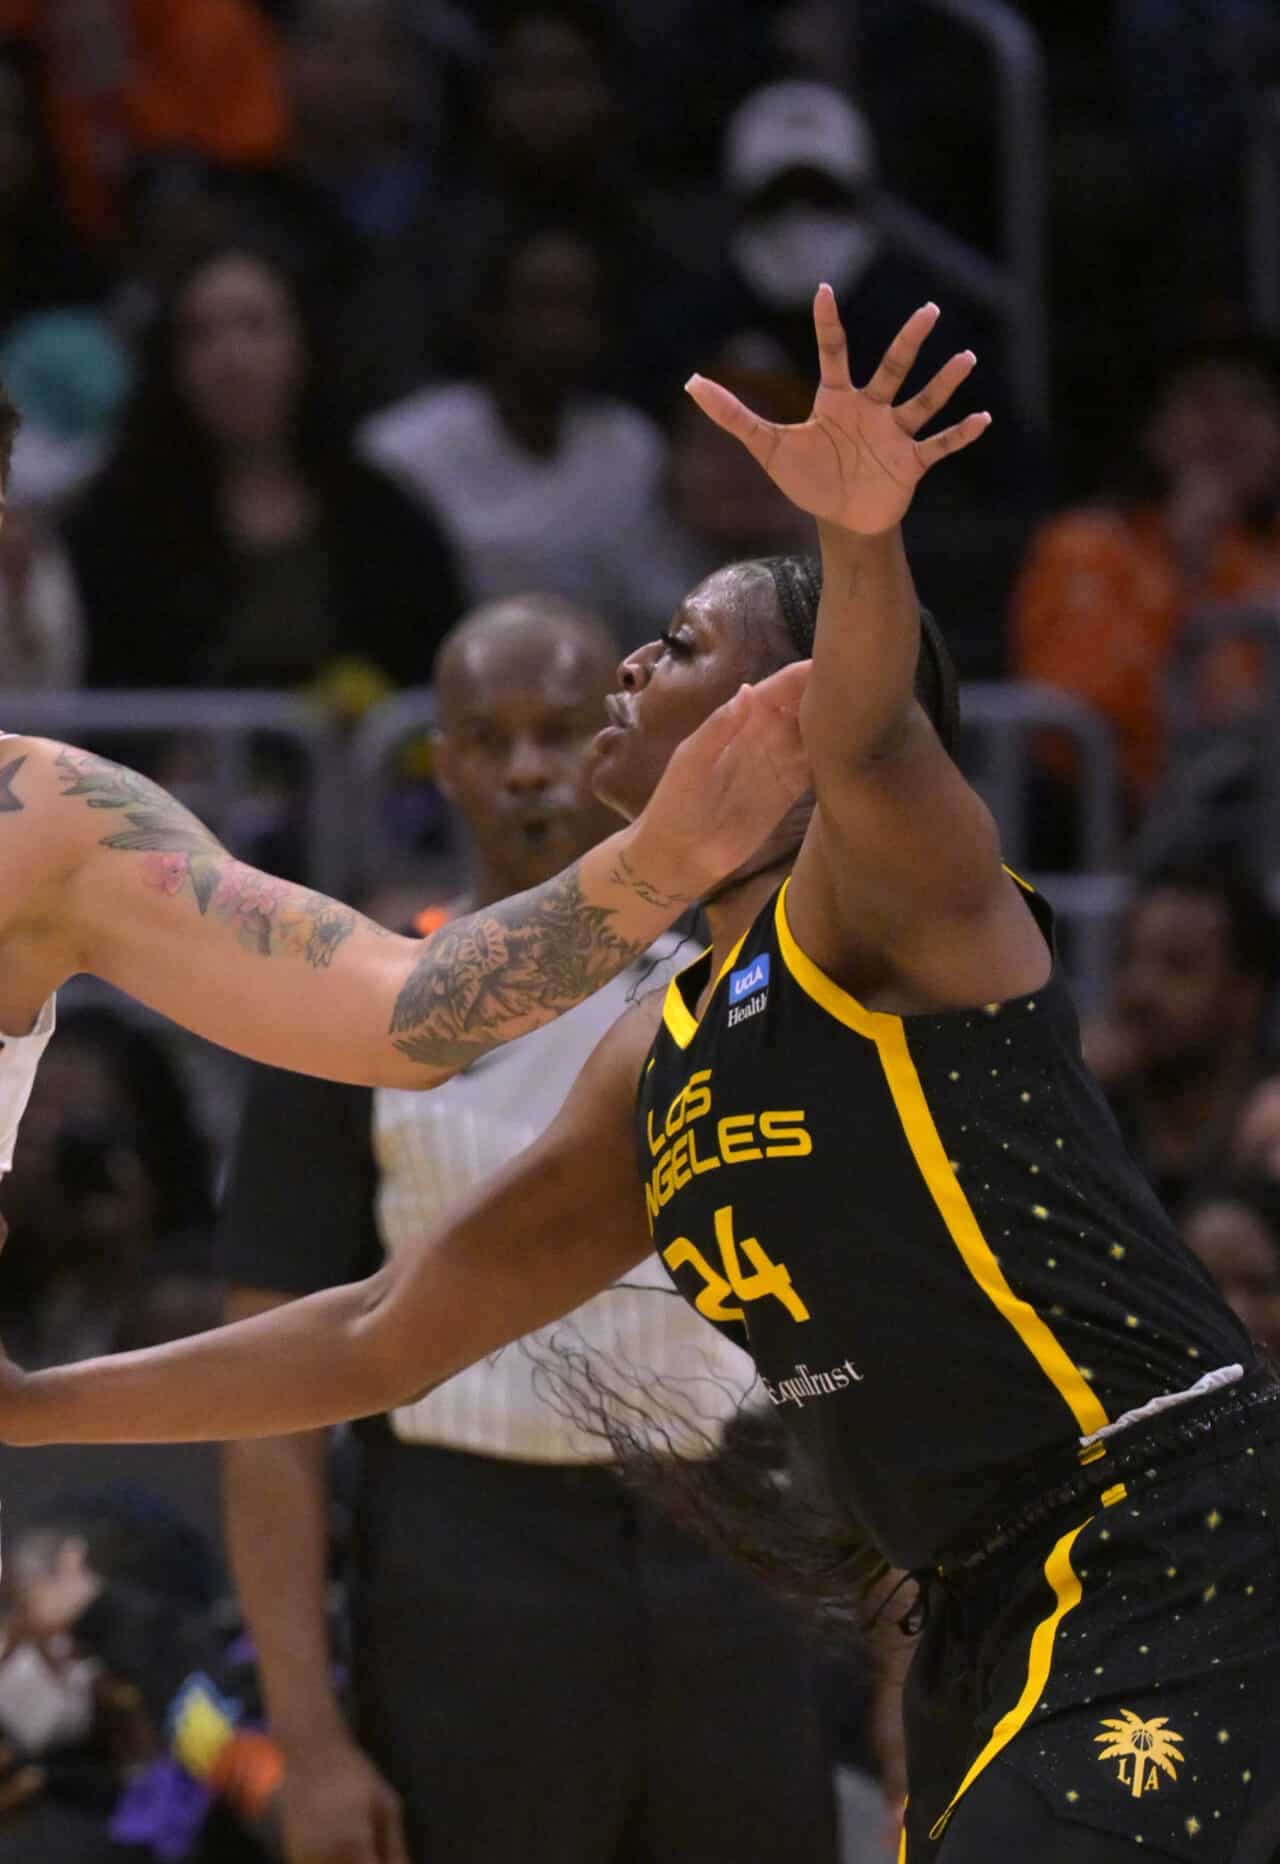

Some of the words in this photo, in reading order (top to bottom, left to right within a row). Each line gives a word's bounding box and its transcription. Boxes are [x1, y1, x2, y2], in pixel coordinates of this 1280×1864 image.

[734, 965, 764, 995] UCLA
[647, 1068, 713, 1157] LOS
[645, 1109, 813, 1228] NGELES
[662, 1204, 811, 1323] 24
